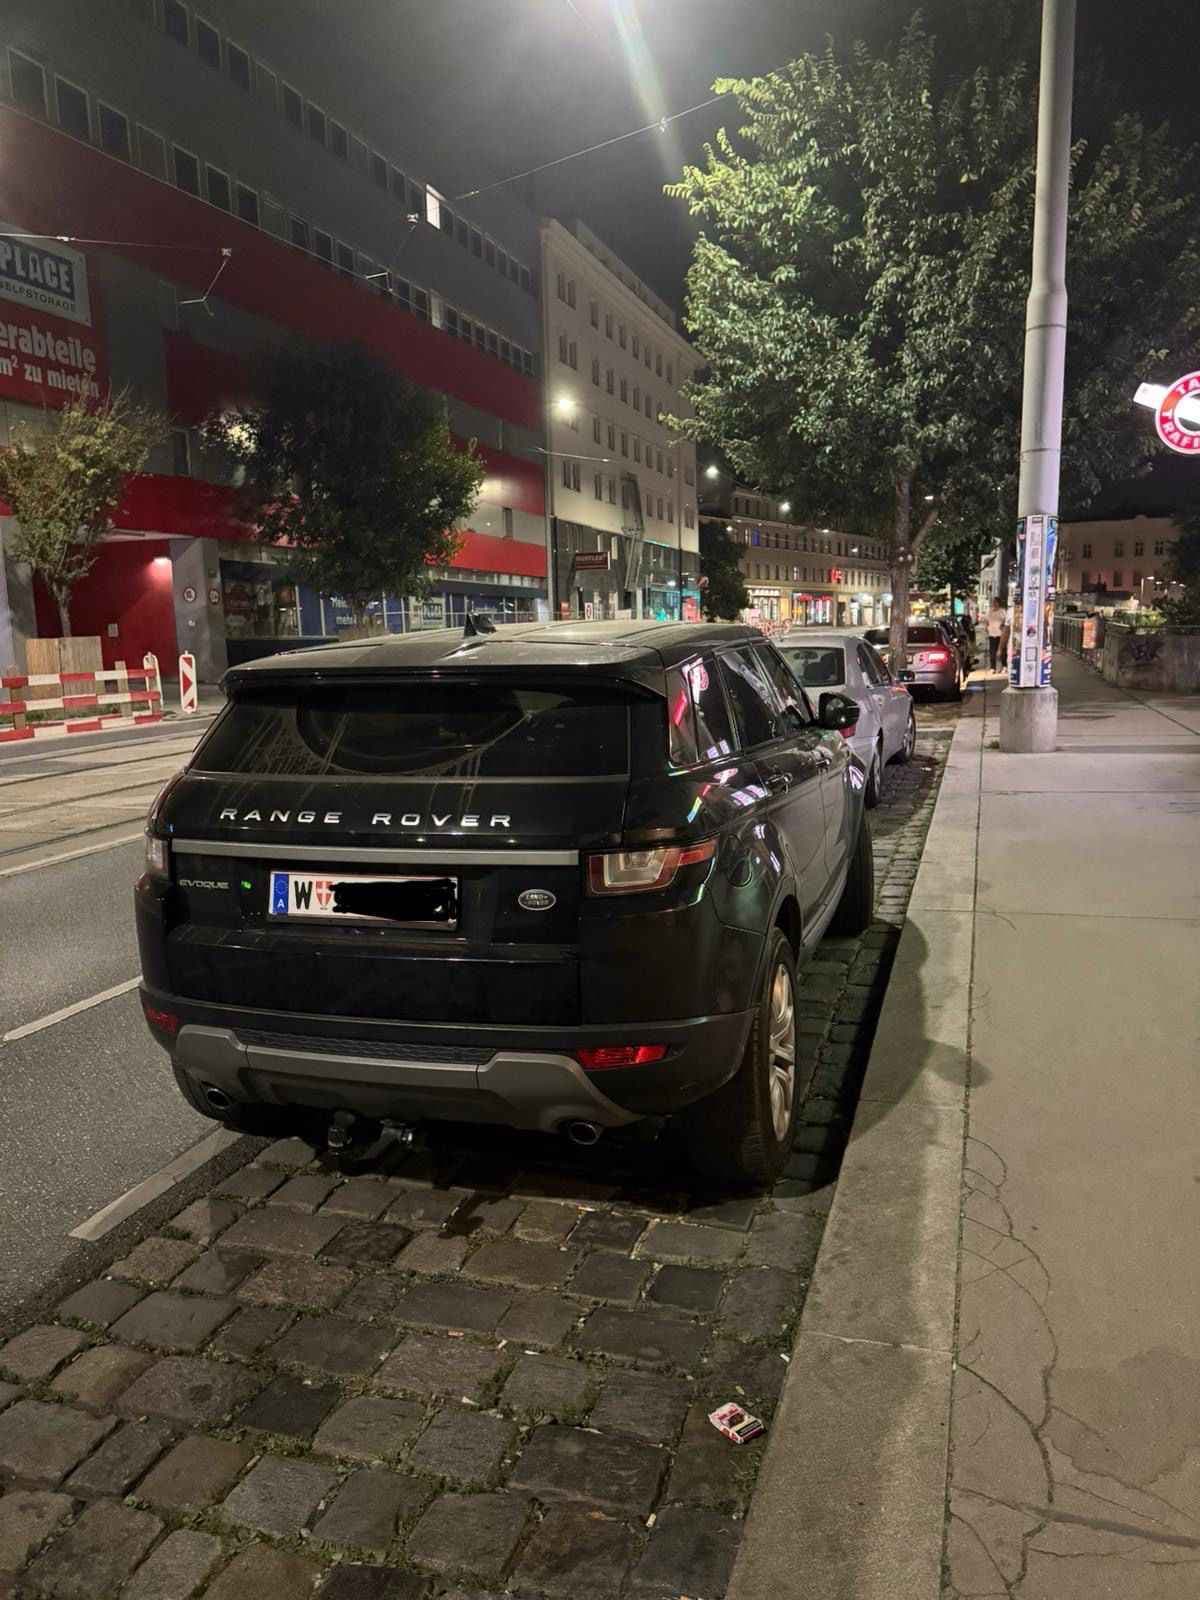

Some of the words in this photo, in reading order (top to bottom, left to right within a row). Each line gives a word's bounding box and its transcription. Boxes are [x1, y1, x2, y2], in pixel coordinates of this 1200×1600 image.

[0, 240, 73, 294] PLACE
[23, 363, 43, 384] zu
[220, 808, 343, 824] RANGE
[371, 813, 511, 828] ROVER
[179, 879, 231, 890] EVOQUE
[277, 898, 285, 909] A
[294, 880, 313, 910] W
